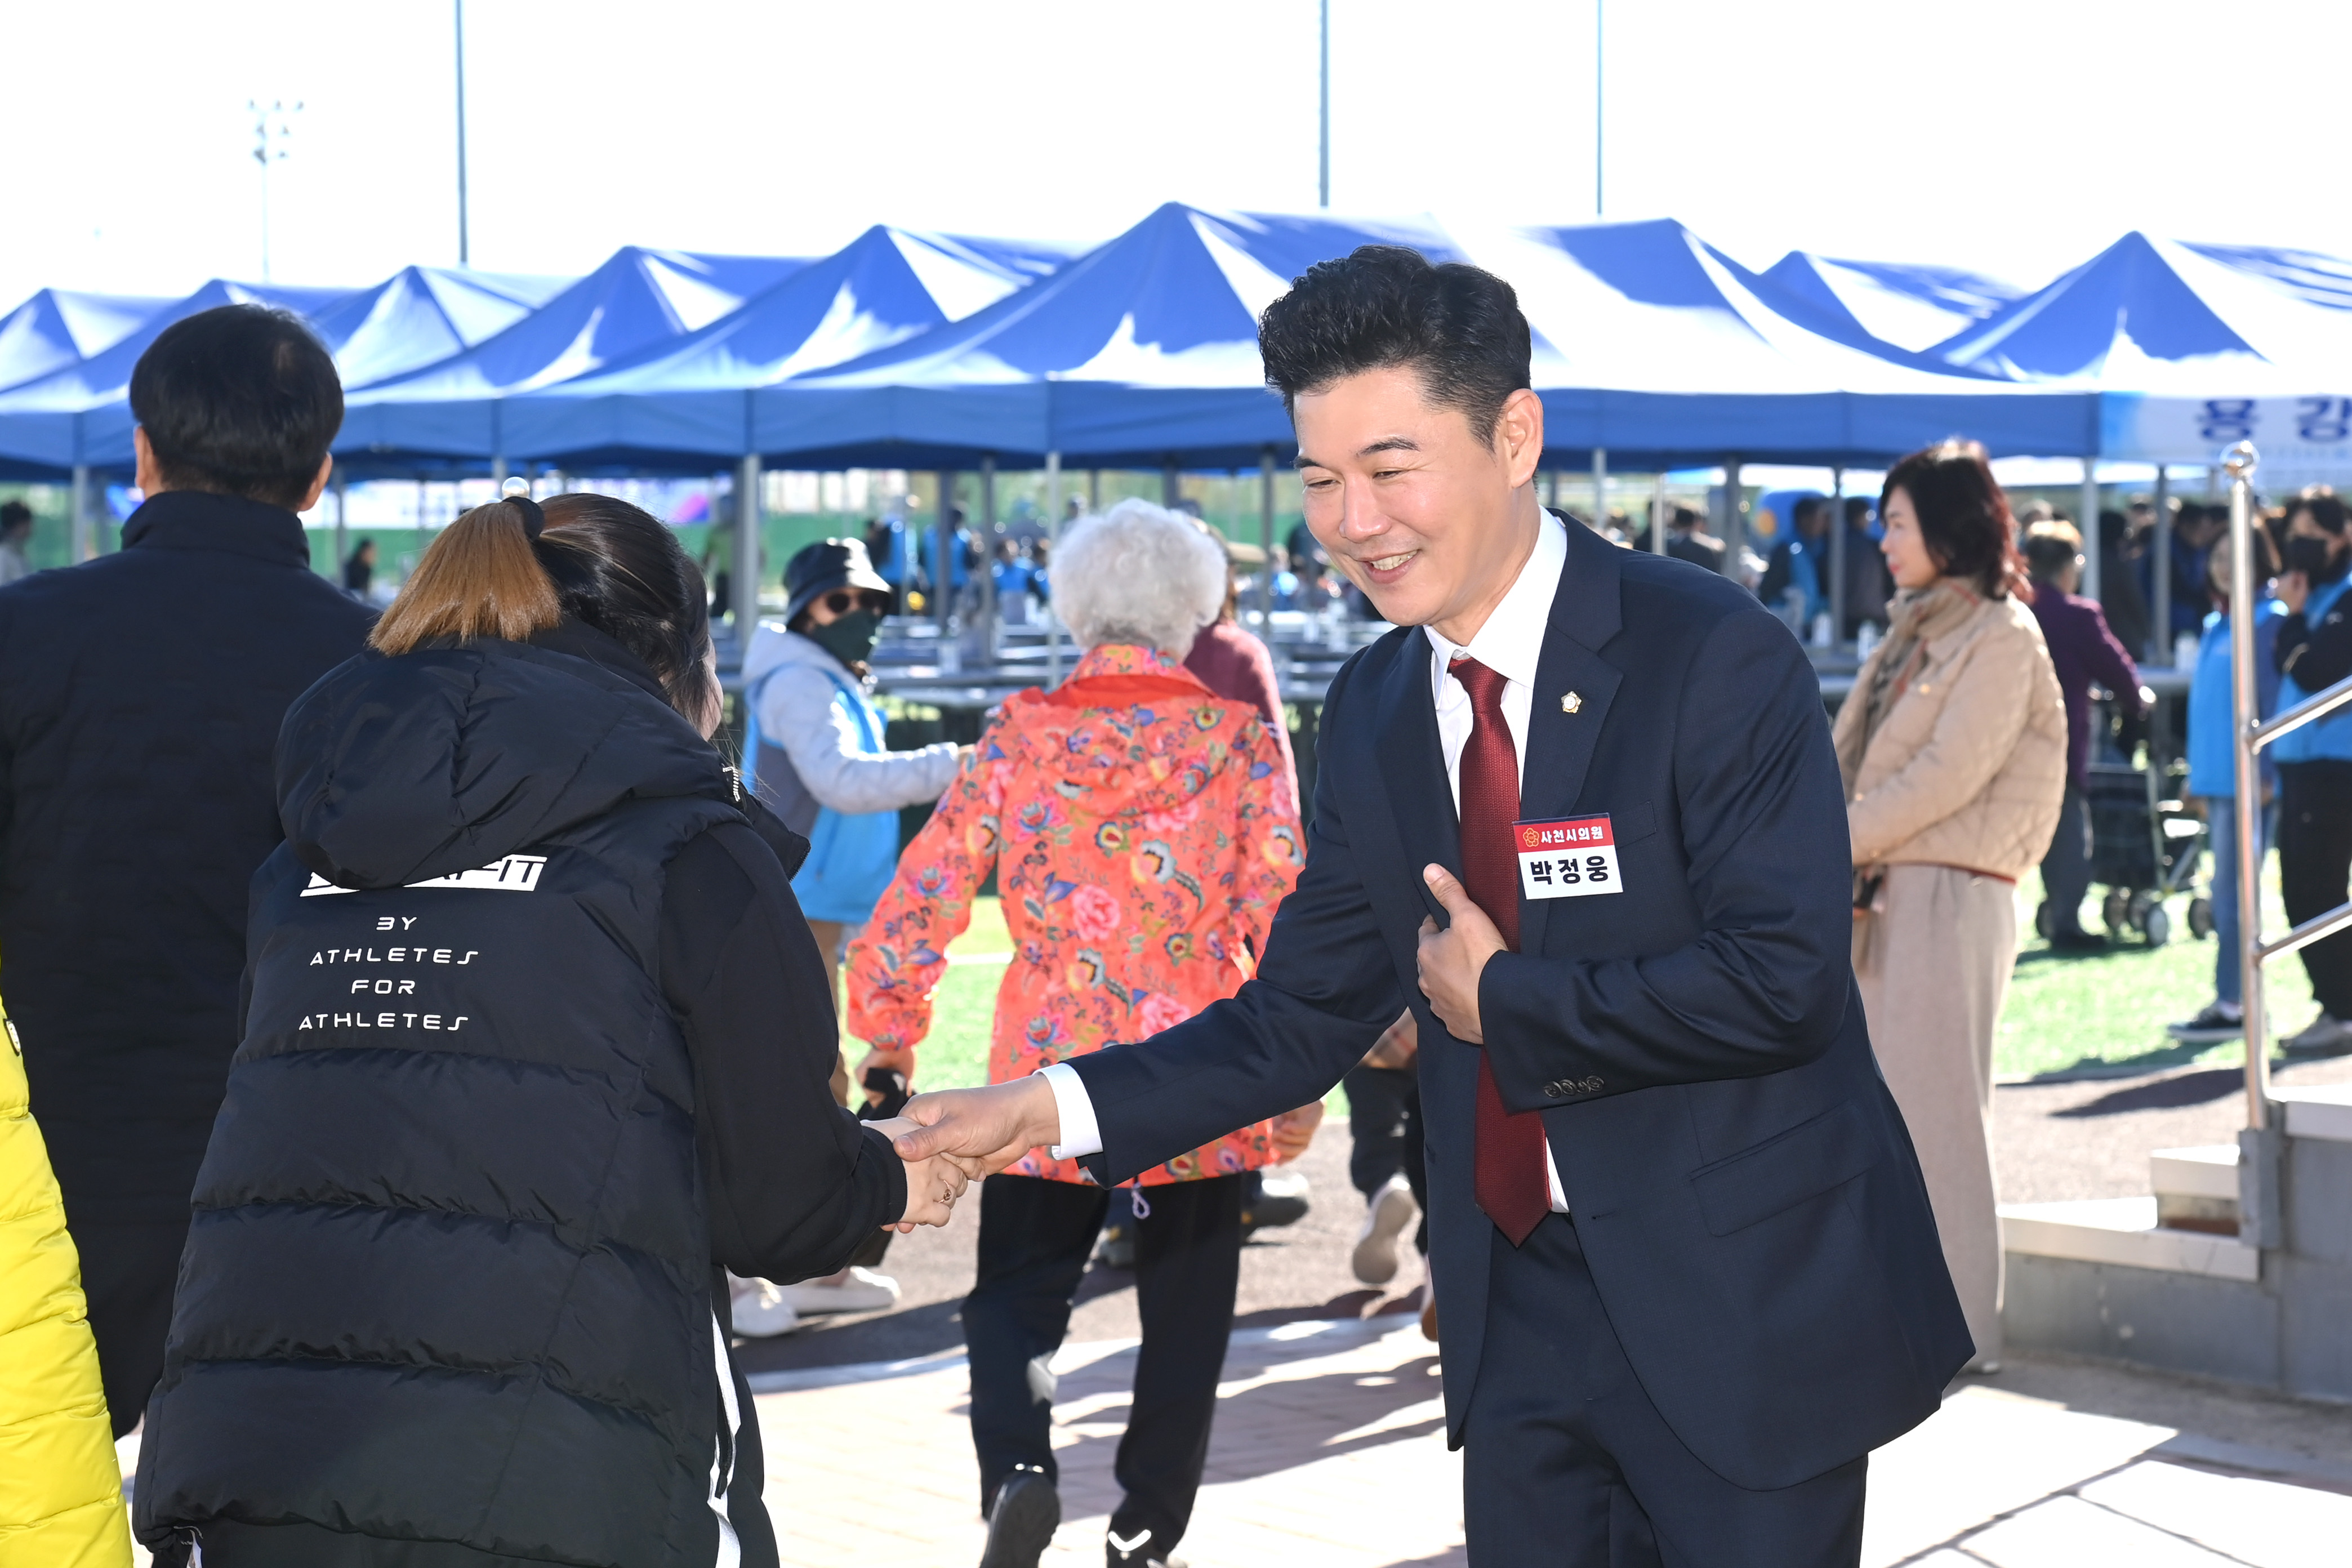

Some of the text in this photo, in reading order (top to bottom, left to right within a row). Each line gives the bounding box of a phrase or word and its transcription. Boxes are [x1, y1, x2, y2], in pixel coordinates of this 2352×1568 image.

[1540, 826, 1604, 844] 사천시의원
[1530, 855, 1609, 885] 박정웅
[376, 916, 417, 930] BY
[310, 947, 479, 966] ATHLETES
[351, 979, 416, 995] FOR
[299, 1012, 469, 1031] ATHLETES
